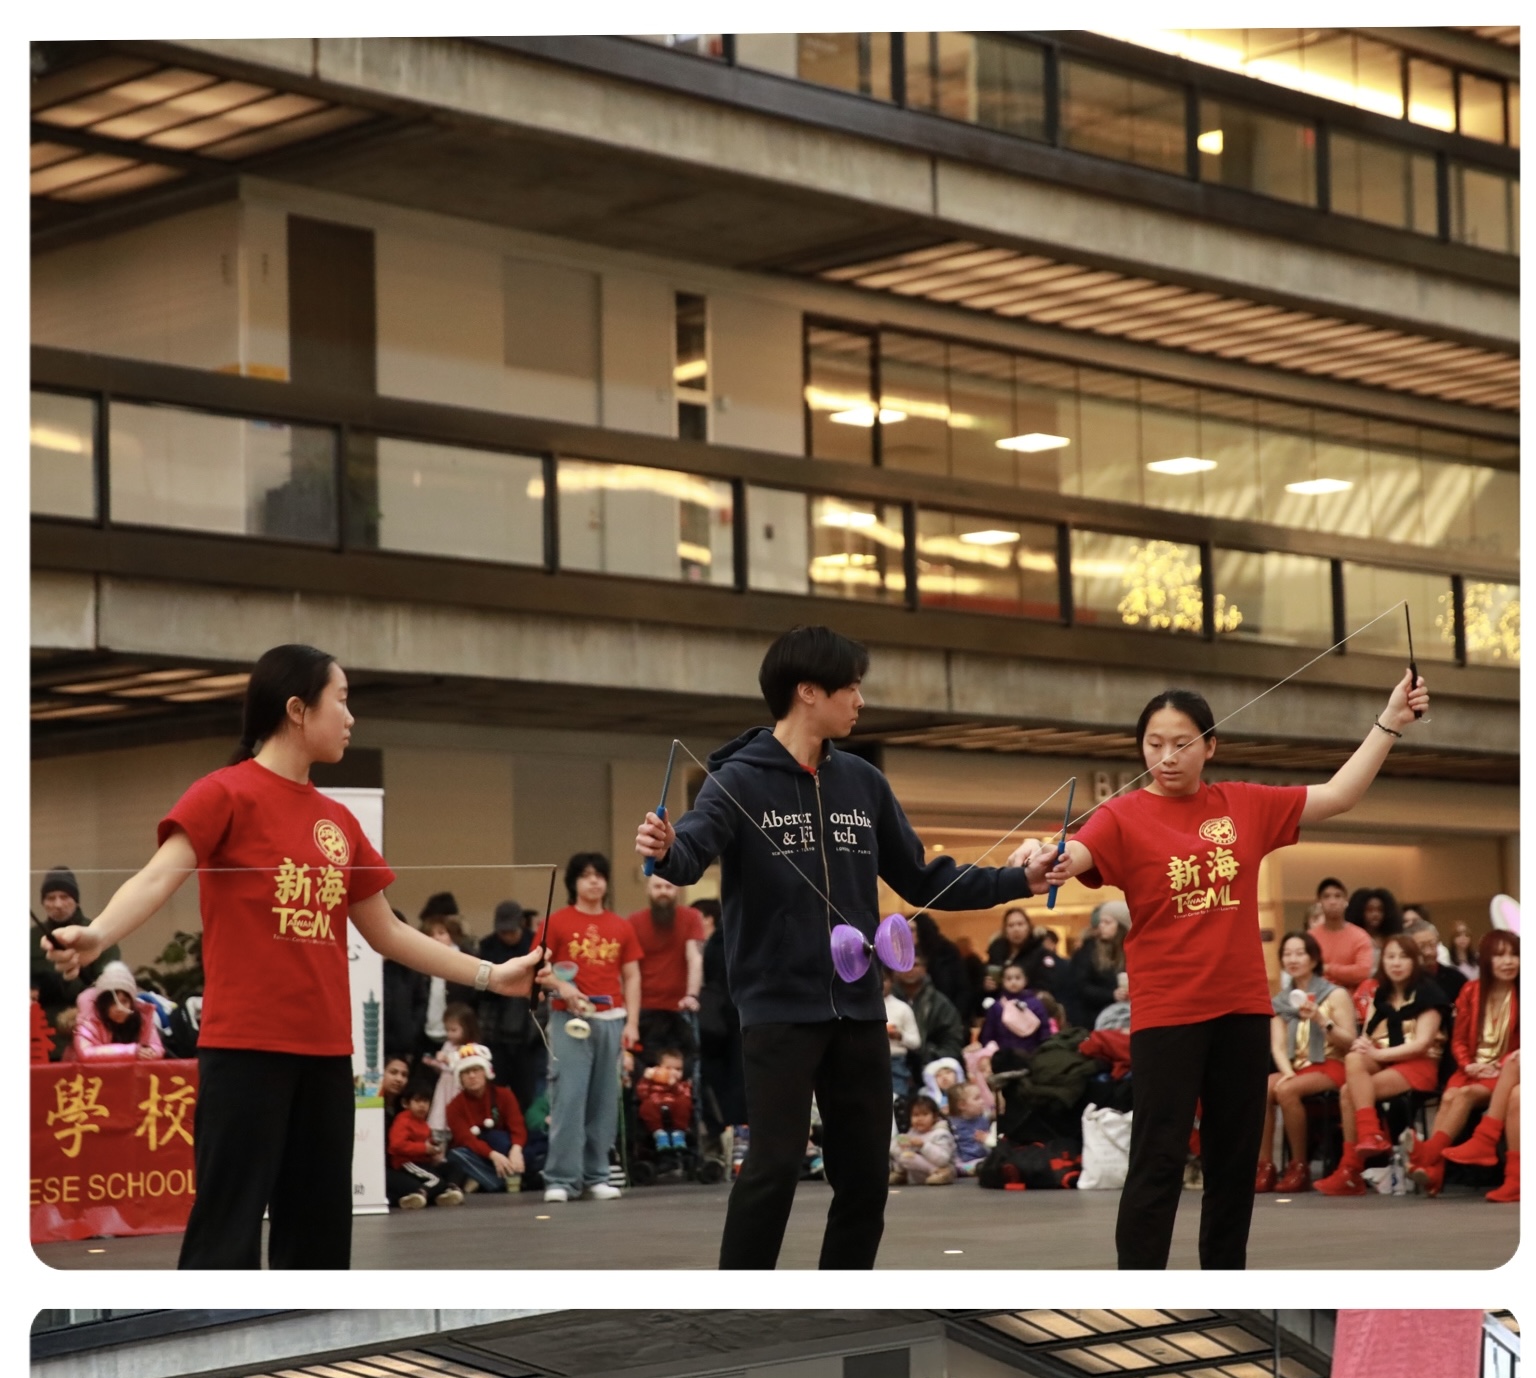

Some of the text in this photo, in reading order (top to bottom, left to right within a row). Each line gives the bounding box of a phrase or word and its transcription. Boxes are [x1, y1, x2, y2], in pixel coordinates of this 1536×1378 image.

[782, 832, 797, 845] &
[833, 826, 858, 845] tch
[273, 856, 348, 911] 新海
[1166, 846, 1240, 892] 新海
[1171, 884, 1240, 914] TCML
[46, 1073, 197, 1158] 學校
